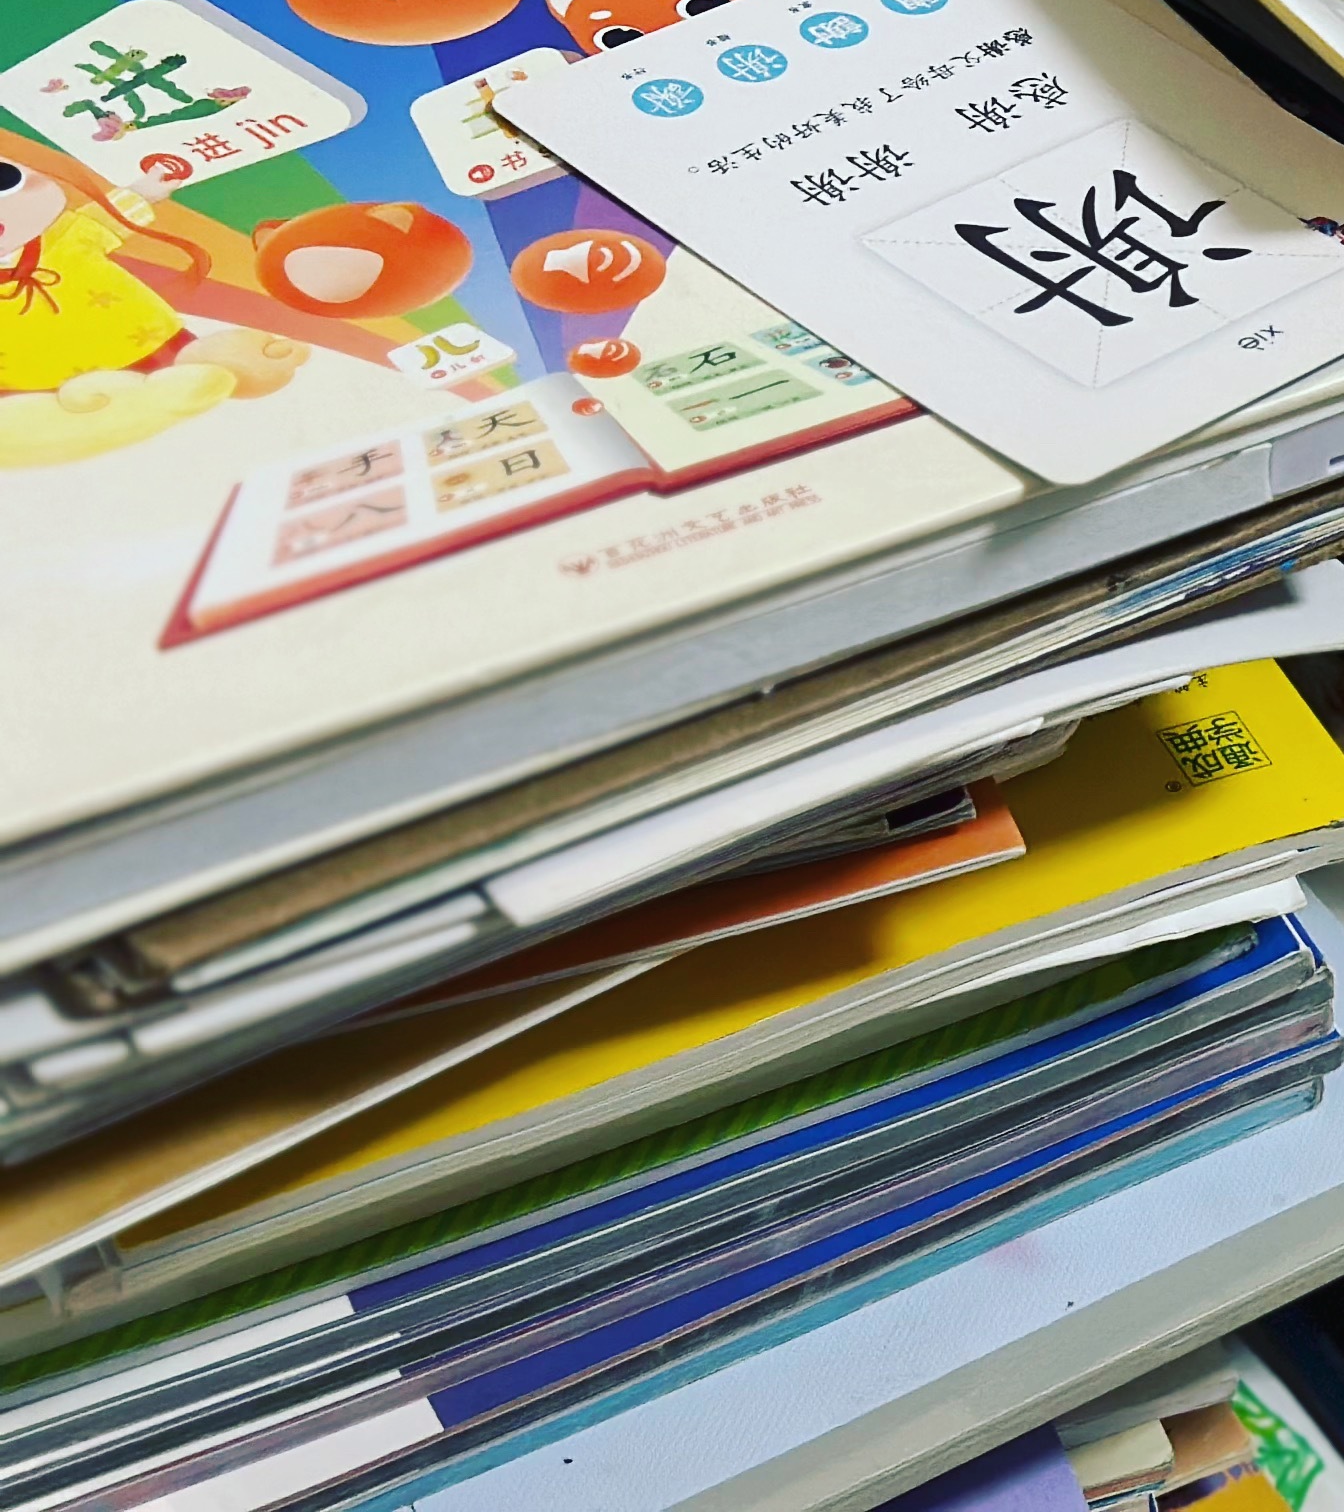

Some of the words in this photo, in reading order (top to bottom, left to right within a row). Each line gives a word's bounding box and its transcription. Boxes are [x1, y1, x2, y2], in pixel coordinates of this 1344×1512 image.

[721, 47, 783, 80] 谢
[687, 27, 1033, 176] 感谢父母给了我美好的生活。
[955, 72, 1069, 133] 感谢
[182, 132, 242, 163] 进
[500, 150, 528, 171] 书
[790, 144, 916, 206] 谢谢
[954, 169, 1253, 326] 谢
[1237, 324, 1284, 351] xiè
[687, 345, 738, 374] 石
[476, 410, 535, 439] 天
[338, 448, 393, 476] 手
